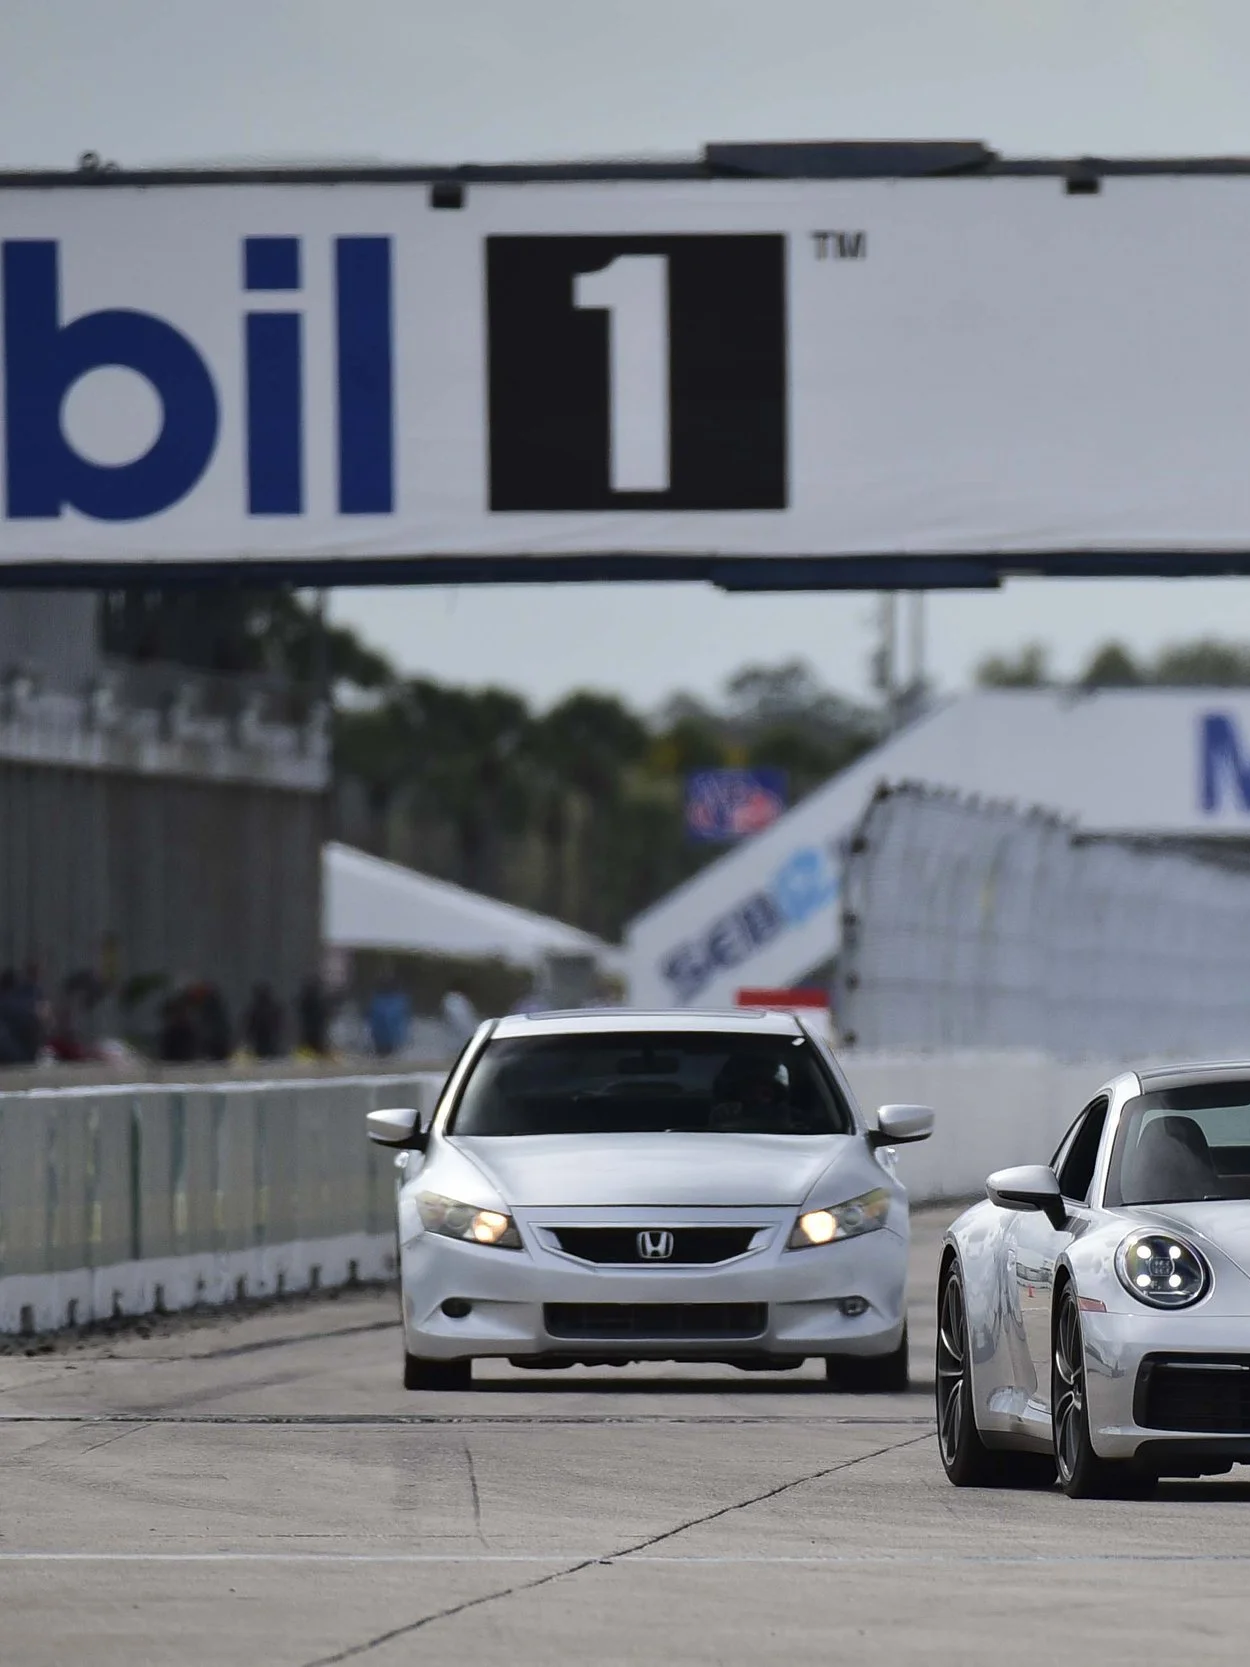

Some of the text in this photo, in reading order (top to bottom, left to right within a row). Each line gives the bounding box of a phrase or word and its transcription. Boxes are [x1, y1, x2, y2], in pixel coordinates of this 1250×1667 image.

[2, 230, 866, 522] bil 1 TM
